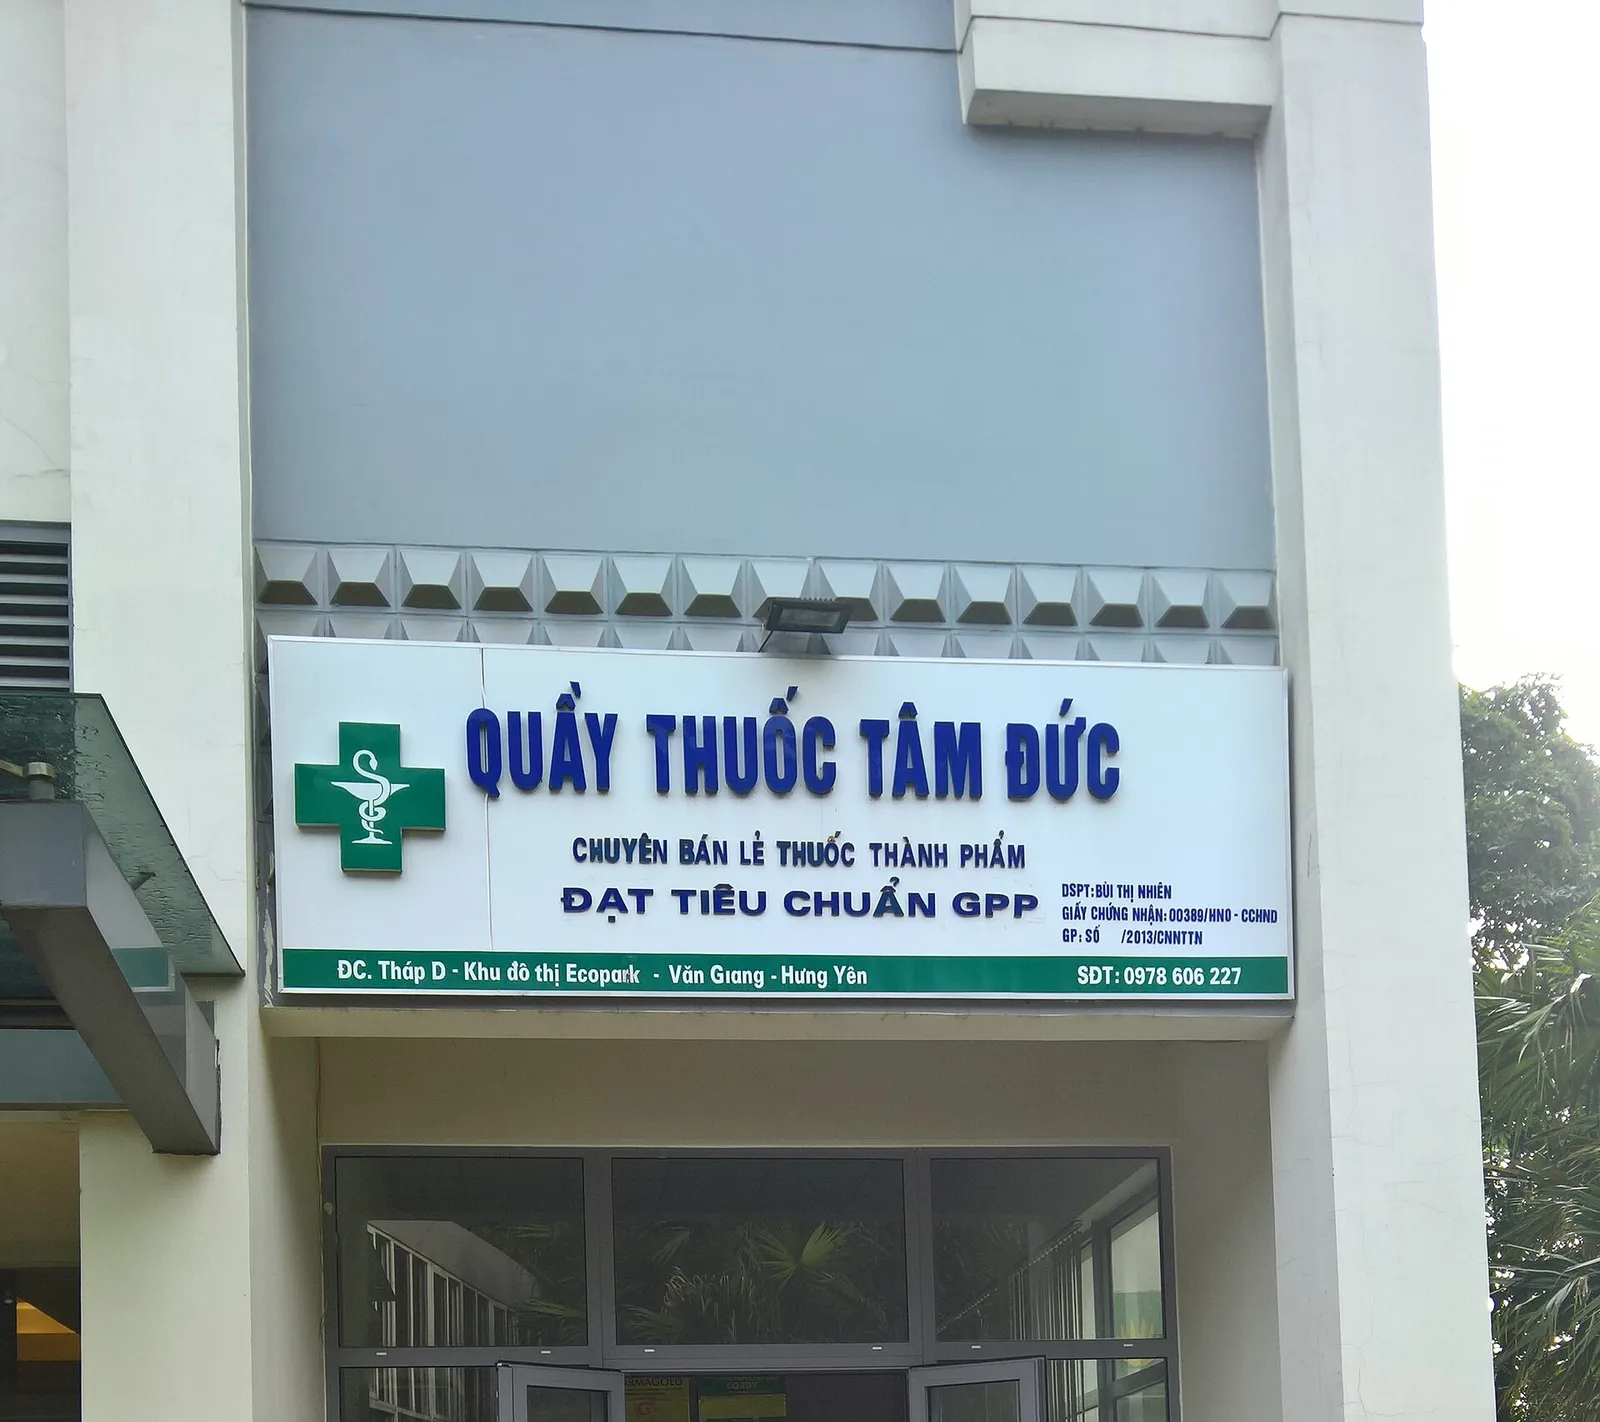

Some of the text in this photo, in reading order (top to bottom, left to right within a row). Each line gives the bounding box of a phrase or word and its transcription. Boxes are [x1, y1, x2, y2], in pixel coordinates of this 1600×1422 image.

[466, 681, 1120, 800] QUẦY THUỐC TÂM ĐỨC
[573, 830, 1025, 869] CHUYÊN BÁN LẺ THUỐC THÀNH PHẨM
[561, 876, 1039, 923] ĐẠT TIÊU CHUẨN GPP
[1117, 884, 1134, 903] THỊ
[1138, 882, 1172, 899] NHIÊN
[1062, 901, 1087, 921] GIẤY
[1091, 902, 1128, 922] CHỨNG
[1241, 909, 1278, 923] CCHND
[1062, 928, 1082, 943] GP:
[1085, 925, 1100, 943] SỐ
[337, 960, 372, 980] ĐC.
[378, 960, 425, 984] Tháp
[431, 961, 446, 980] D
[464, 961, 500, 981] Khu
[507, 960, 530, 981] đô
[535, 963, 560, 987] thị
[566, 963, 640, 988] Ecopark
[668, 964, 704, 984] Văn
[781, 965, 828, 989] Hưng
[833, 965, 867, 985] Yên
[1124, 966, 1167, 985] 0978
[1172, 967, 1205, 985] 606
[1209, 967, 1242, 985] 227
